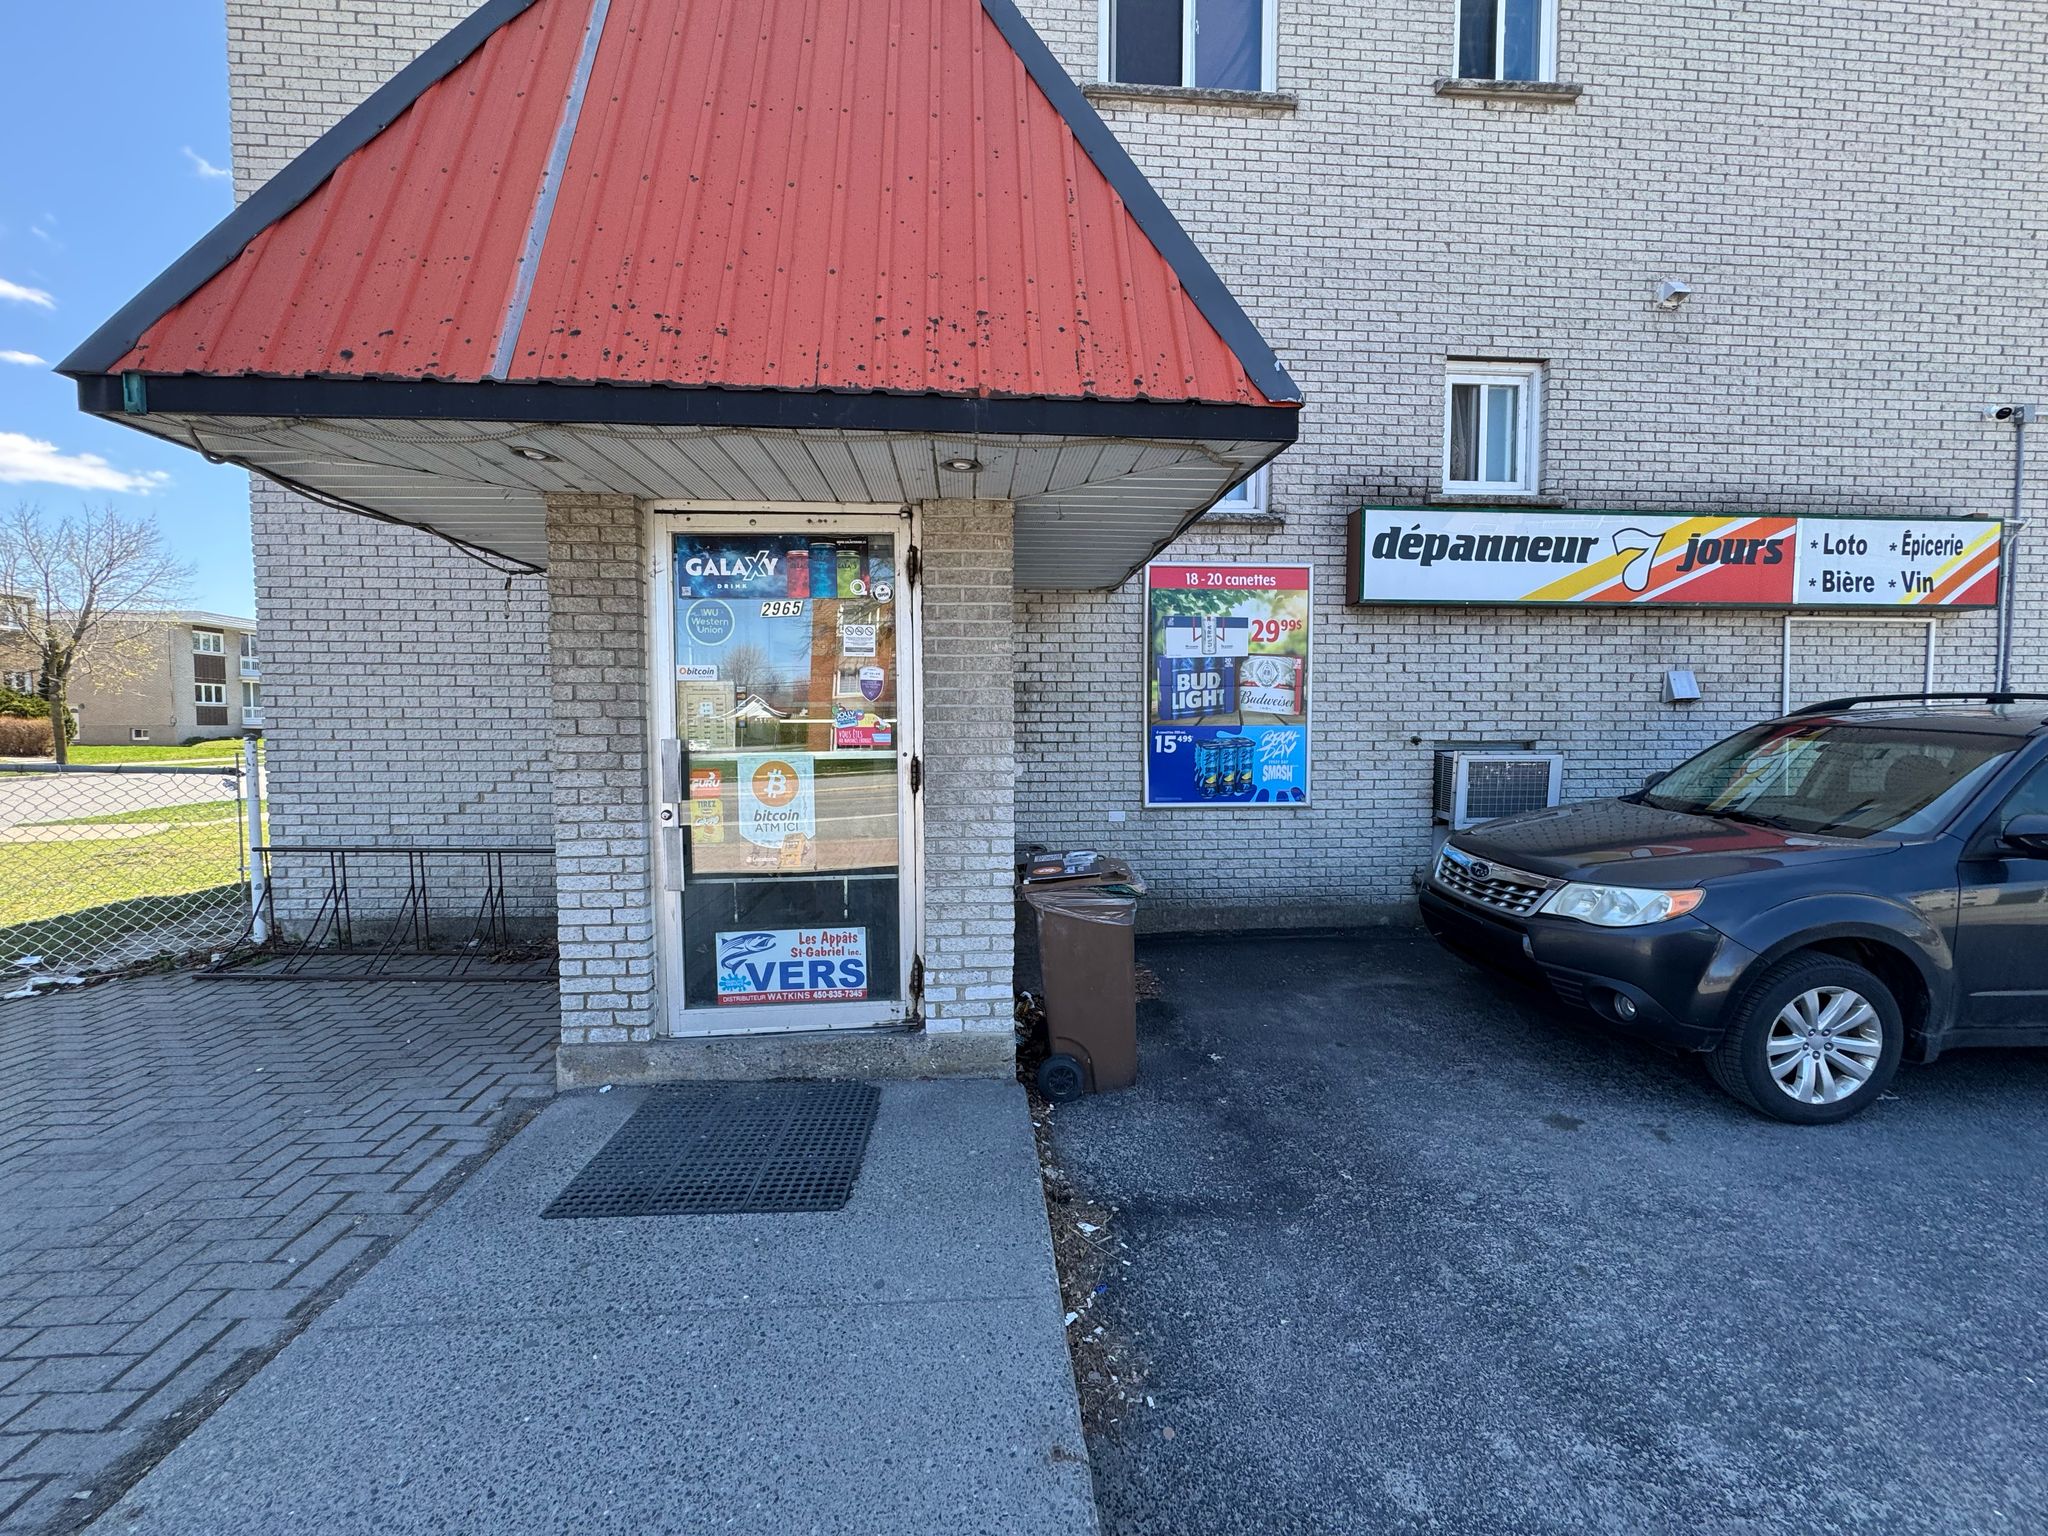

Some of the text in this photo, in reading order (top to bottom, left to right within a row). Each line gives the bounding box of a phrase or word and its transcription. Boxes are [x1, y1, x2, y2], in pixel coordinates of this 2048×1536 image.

[1823, 529, 1964, 561] Loto Épicerie
[685, 550, 778, 582] GALAXY
[1372, 524, 1784, 593] dépanneur 7 jours
[1186, 573, 1199, 586] 18
[1207, 573, 1223, 586] 20
[1225, 573, 1277, 586] canettes
[1822, 570, 1934, 593] Bière Vin
[703, 608, 719, 616] WU
[762, 601, 801, 617] 2965
[691, 617, 729, 626] Western
[697, 626, 724, 635] Union
[687, 667, 715, 675] bitcoin
[1177, 672, 1221, 691] BUD
[1172, 690, 1224, 710] LIGHT
[1240, 690, 1295, 707] Budweiser
[1257, 741, 1297, 762] DAY
[1262, 764, 1293, 782] SMASH
[691, 778, 720, 791] GURU
[697, 800, 716, 808] TIREZ
[754, 809, 800, 822] bitcoin
[755, 822, 799, 832] ATM ICI
[798, 930, 858, 948] Les Appâts
[790, 946, 862, 958] St-Gabriel inc.
[745, 958, 865, 992] VERS
[767, 992, 811, 1001] WATKINS
[813, 990, 863, 999] 450-835-7345
